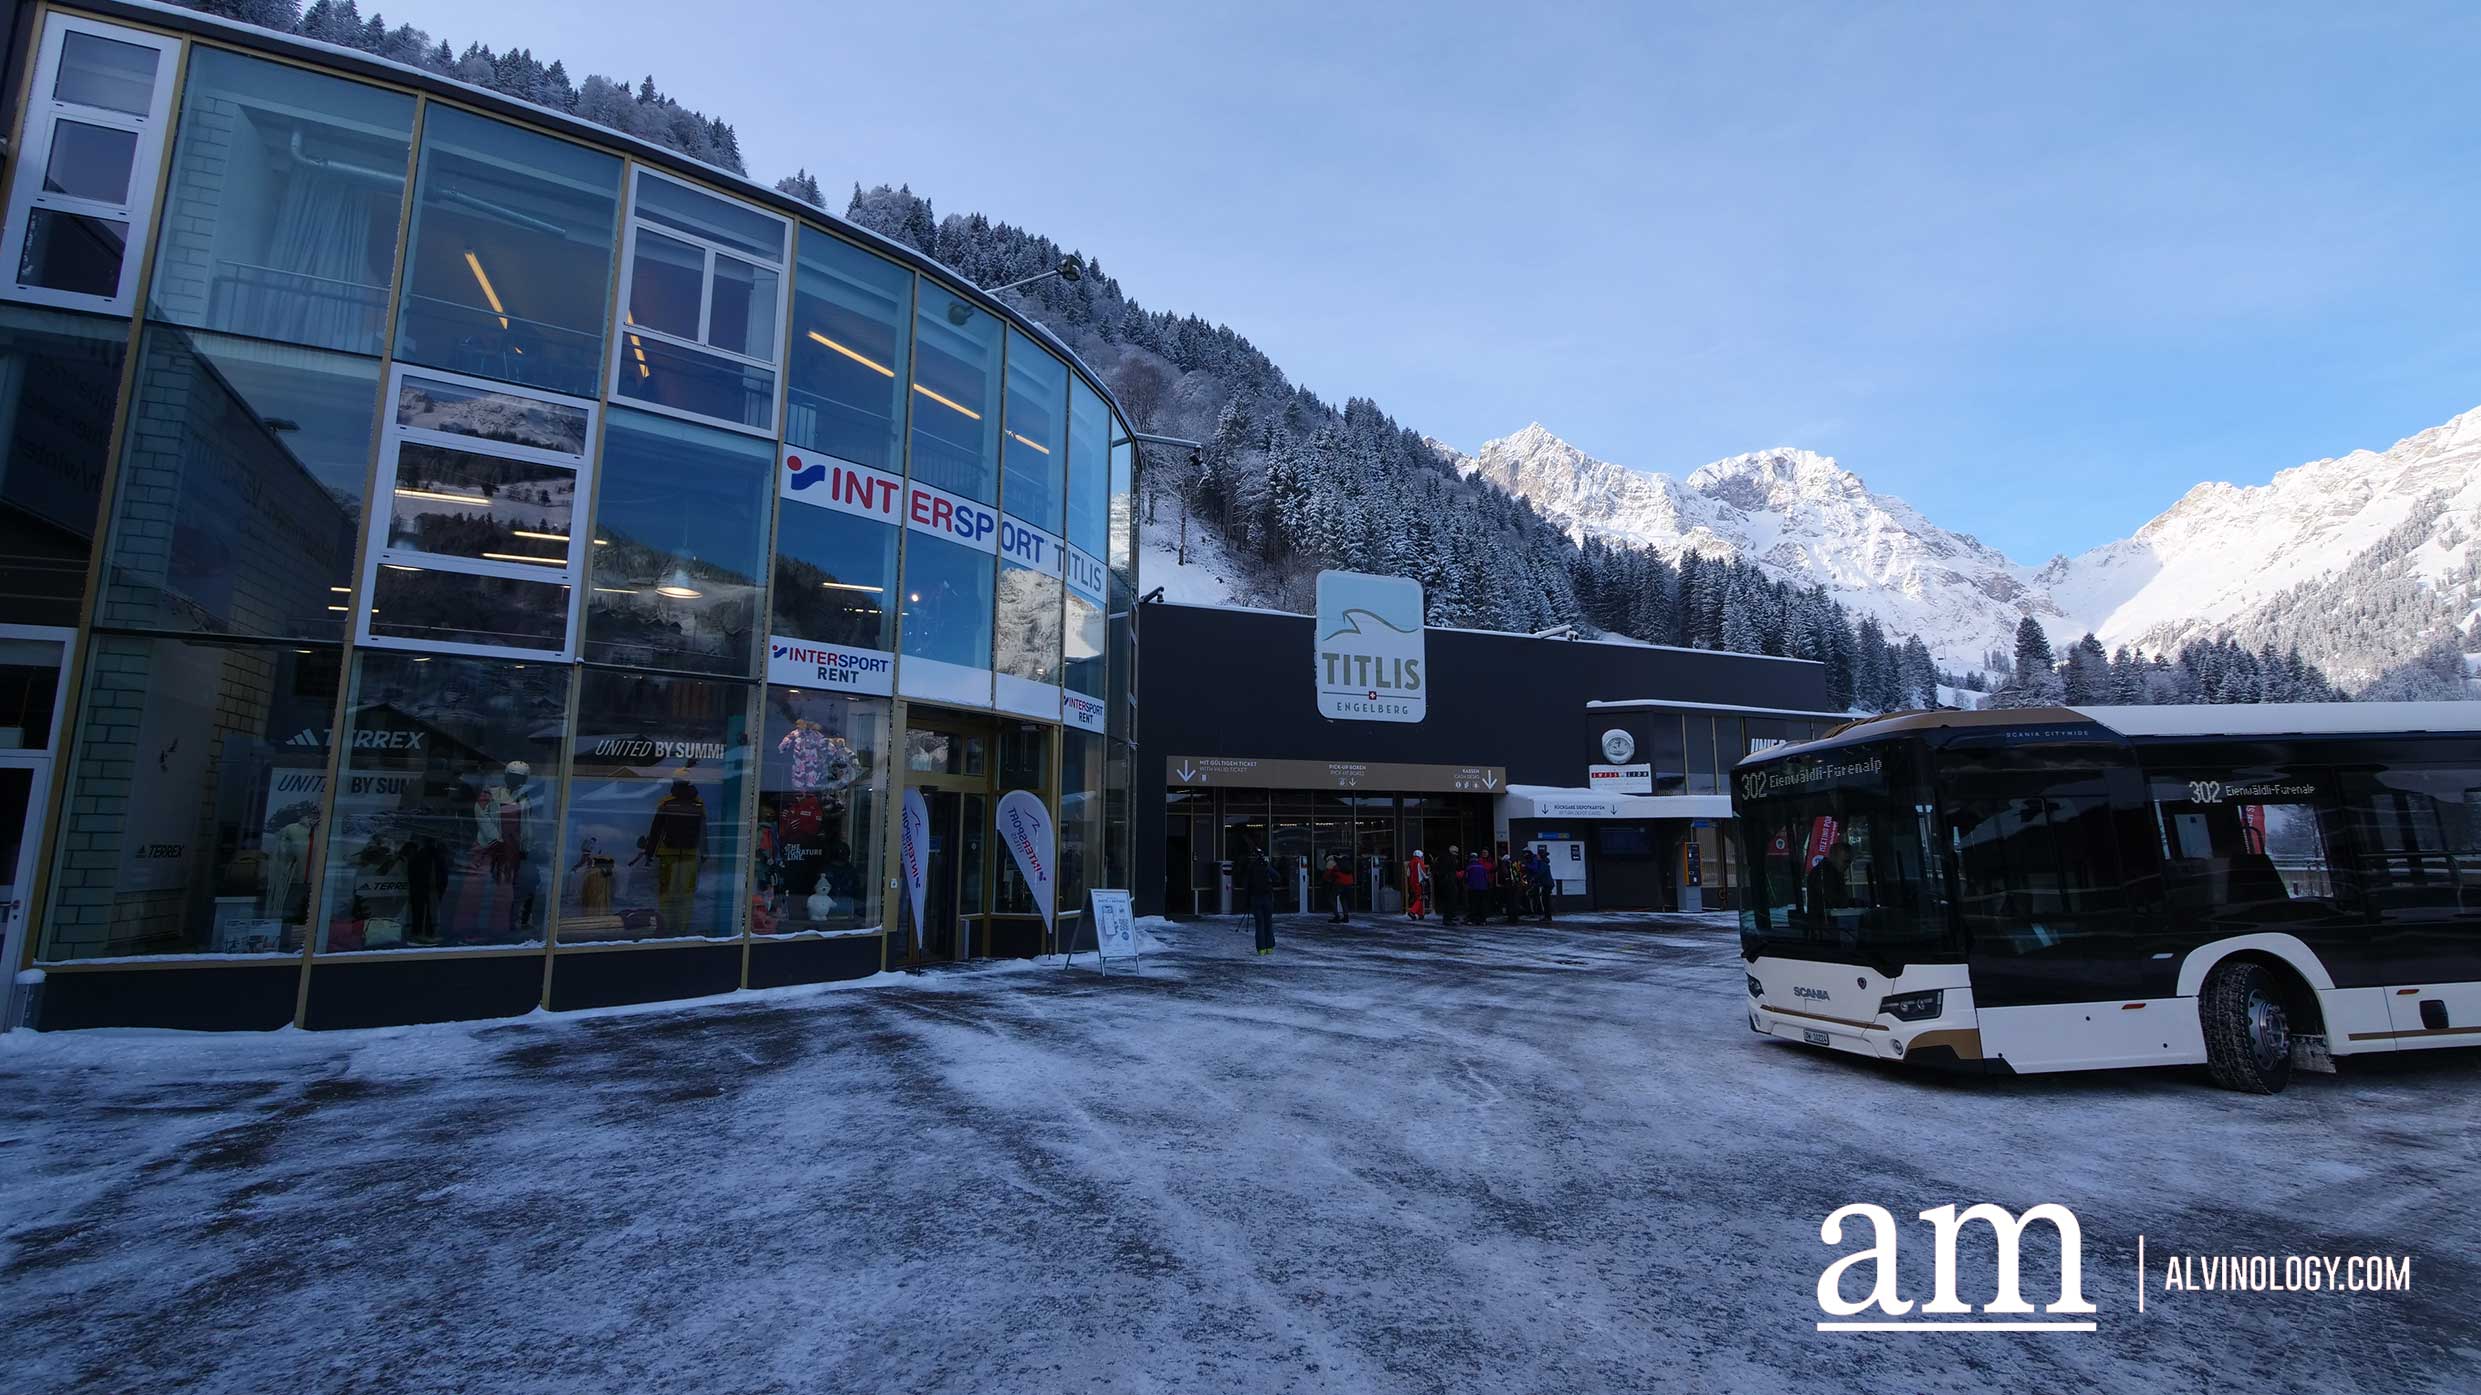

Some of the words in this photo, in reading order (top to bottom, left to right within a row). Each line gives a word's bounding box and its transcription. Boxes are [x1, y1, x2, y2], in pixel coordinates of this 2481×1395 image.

[831, 467, 1045, 563] INTERSPORT
[1054, 543, 1102, 592] TITLIS
[789, 647, 889, 673] INTERSPORT
[817, 666, 859, 684] RENT
[1322, 652, 1421, 691] TITLIS
[1068, 696, 1104, 716] INTERSPORT
[1337, 701, 1409, 715] ENGELBERG
[1078, 711, 1093, 725] RENT
[595, 740, 652, 757] UNITED
[654, 741, 676, 758] BY
[351, 776, 373, 794] BY
[1741, 771, 1768, 800] 302
[2189, 781, 2223, 803] 302
[150, 844, 184, 858] TERREX
[374, 881, 409, 890] TERRE
[1793, 986, 1831, 1001] SCANIA
